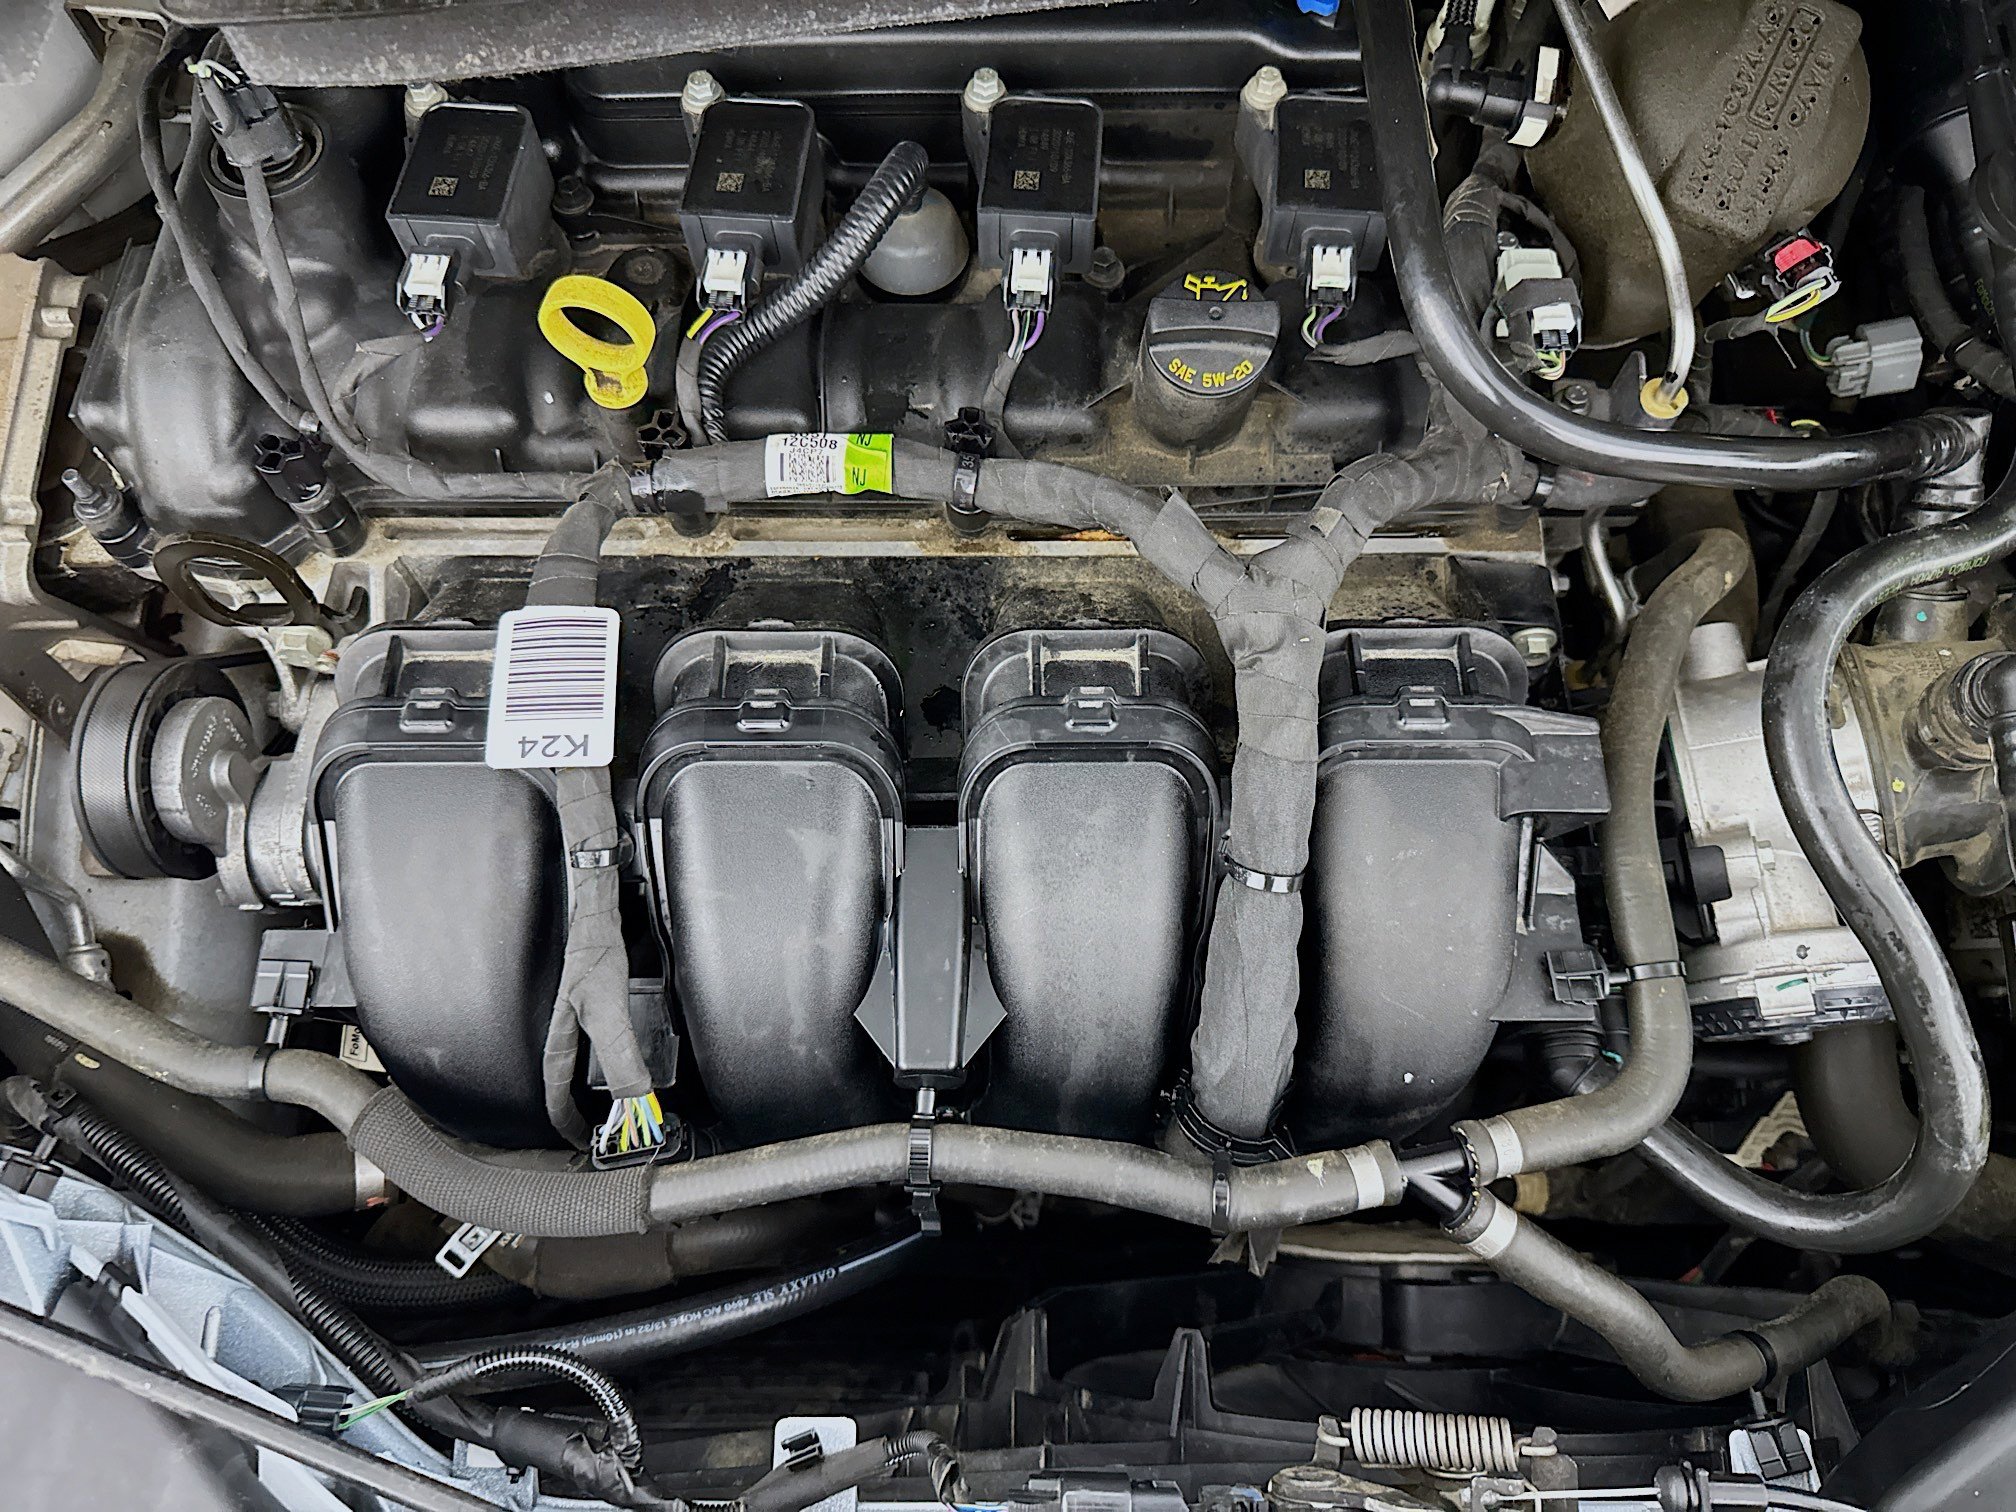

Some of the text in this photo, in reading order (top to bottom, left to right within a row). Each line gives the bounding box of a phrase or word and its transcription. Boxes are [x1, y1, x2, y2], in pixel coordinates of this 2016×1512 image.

[1168, 357, 1255, 388] SAE 5W-20
[782, 437, 838, 450] 12C508
[852, 467, 867, 486] NJ
[517, 734, 589, 759] K24
[350, 1027, 361, 1056] FoMo
[778, 1267, 836, 1296] GALAXY
[751, 1288, 775, 1305] SLE
